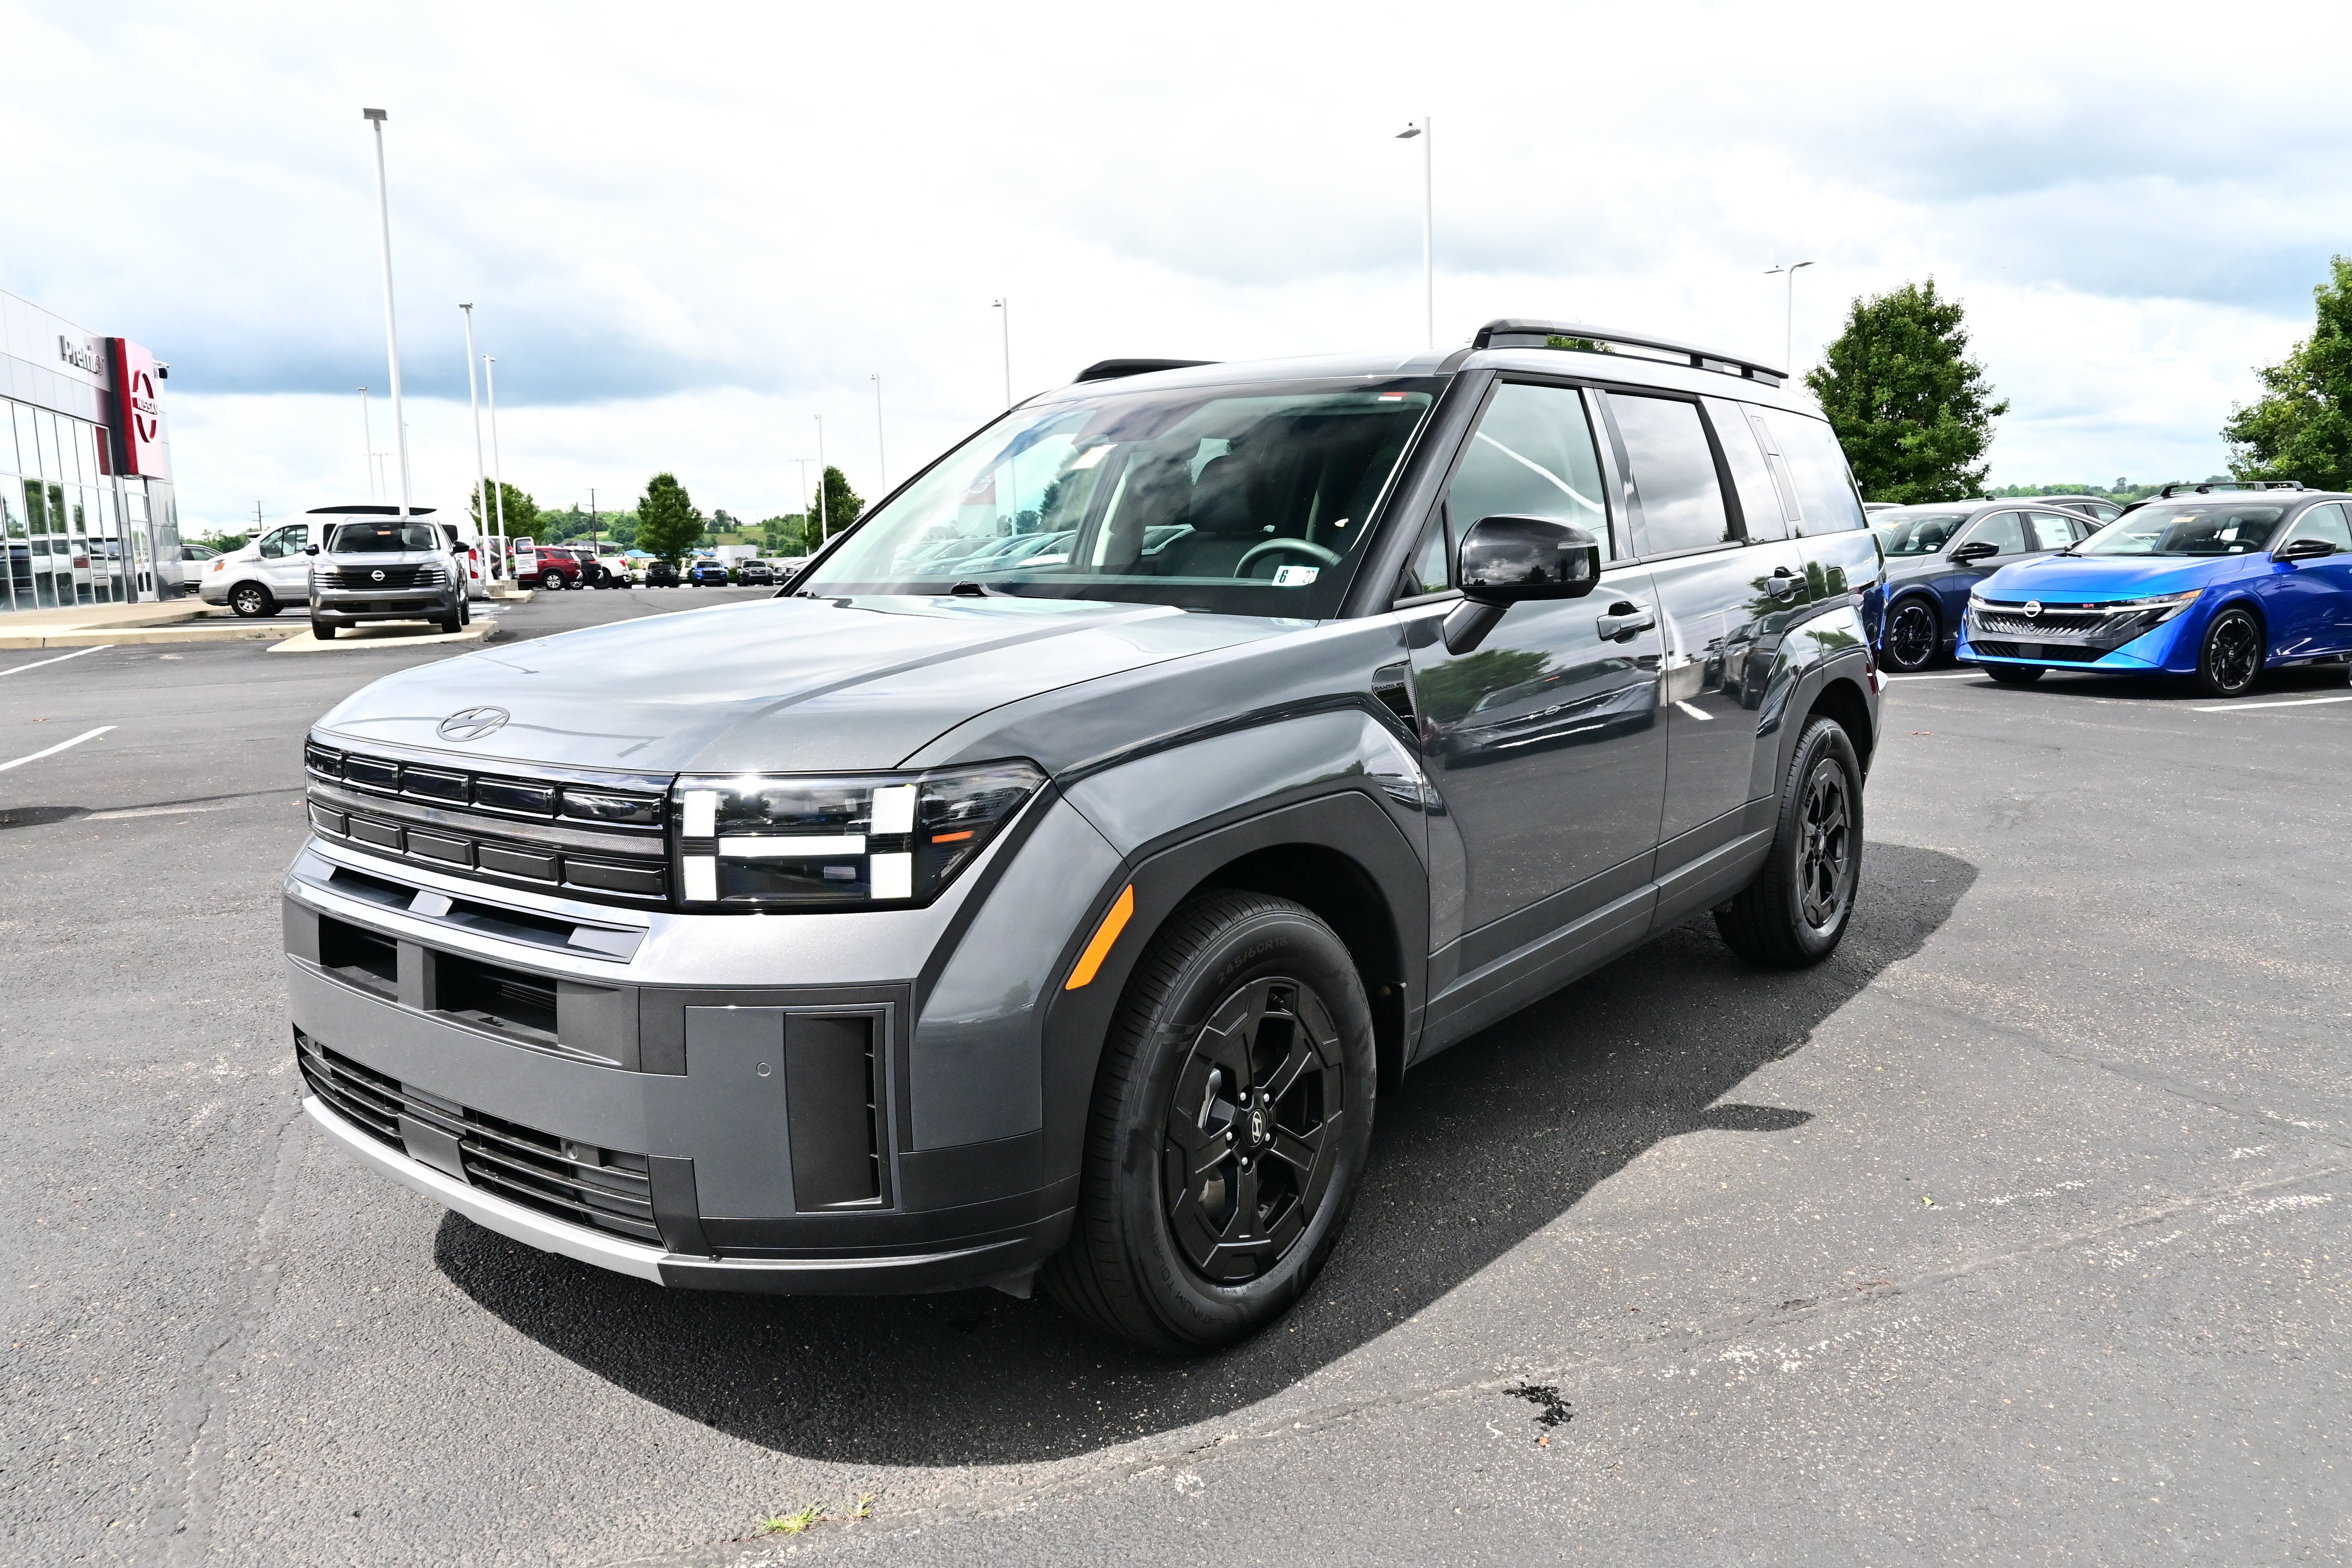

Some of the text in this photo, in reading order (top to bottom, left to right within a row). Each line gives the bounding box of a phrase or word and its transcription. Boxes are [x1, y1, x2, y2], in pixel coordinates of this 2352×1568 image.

[60, 335, 105, 376] Premier
[136, 398, 158, 415] NISSAN
[1279, 569, 1315, 584] 6 27
[1374, 683, 1396, 692] SANTA
